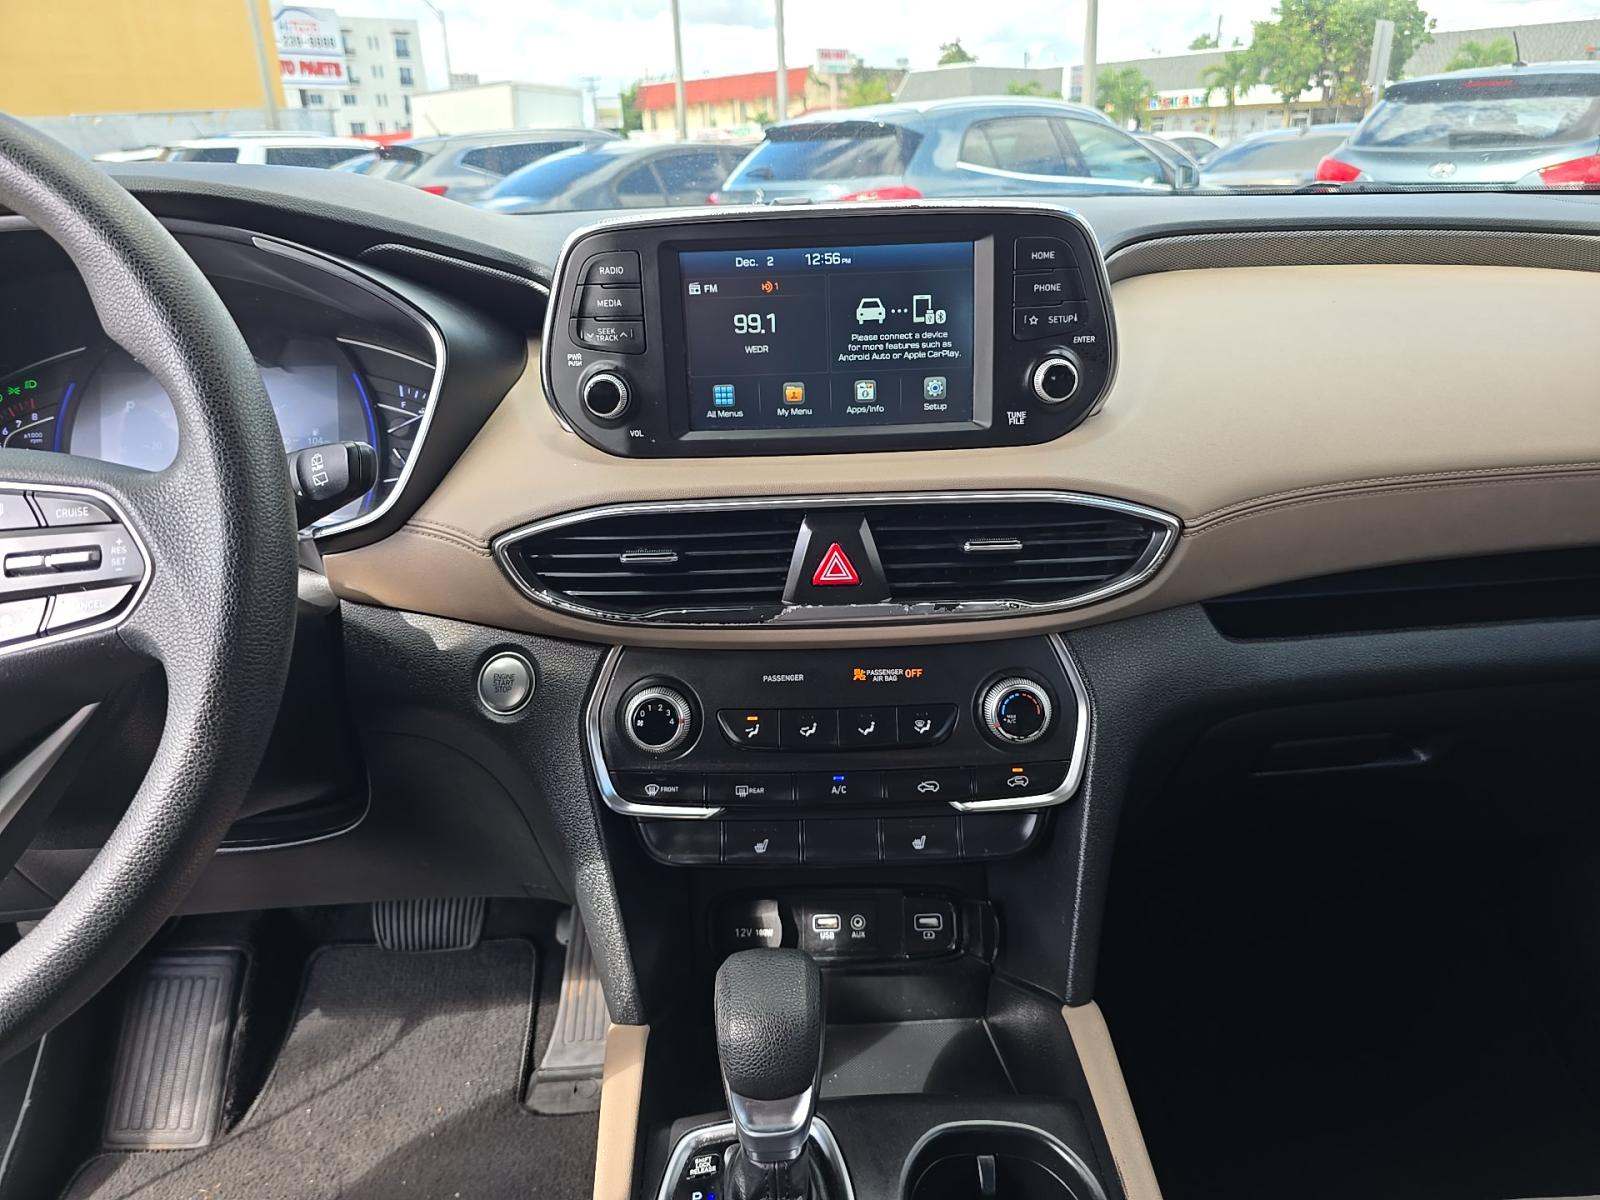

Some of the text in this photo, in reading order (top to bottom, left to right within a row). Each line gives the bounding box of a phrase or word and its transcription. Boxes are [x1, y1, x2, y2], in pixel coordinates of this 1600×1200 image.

[804, 252, 841, 266] 12:56
[1031, 251, 1055, 260] HOME
[735, 256, 774, 267] Dec. 2
[599, 266, 624, 275] RADIO
[703, 284, 718, 293] FM
[1033, 283, 1062, 292] PHONE
[597, 299, 622, 308] MEDIA
[733, 313, 776, 334] 99.1
[1048, 315, 1073, 324] SETUP
[597, 327, 616, 335] SEEK
[596, 334, 619, 342] TRACK
[851, 334, 878, 342] Please
[879, 332, 913, 341] connect
[921, 331, 948, 339] device
[1072, 335, 1096, 344] ENTER
[744, 345, 769, 354] WEDR
[885, 342, 920, 350] features
[567, 353, 582, 361] PWR
[838, 353, 870, 361] Android
[871, 352, 891, 360] Auto
[903, 351, 927, 360] Apple
[927, 350, 962, 359] CarPlay.
[846, 405, 885, 414] Apps/Info
[923, 402, 948, 412] Setup
[706, 409, 744, 418] All Menus
[777, 407, 812, 417] My Menu
[1006, 411, 1027, 419] TUNE
[15, 420, 22, 428] 7
[1008, 417, 1025, 425] FILE
[2, 427, 8, 436] 6
[629, 429, 644, 437] VOL
[55, 506, 89, 518] CRUISE
[762, 673, 804, 682] PASSENGER
[866, 668, 923, 679] PASSENGER OFF
[495, 685, 512, 693] STOP
[647, 704, 652, 712] 1
[657, 704, 663, 712] 2
[666, 709, 671, 717] 3
[831, 785, 847, 795] A/C
[735, 928, 752, 938] 12V
[819, 931, 835, 940] USB
[851, 930, 866, 939] AUX
[694, 1156, 712, 1164] SHIFT
[690, 1165, 717, 1176] RELEASE
[692, 1191, 703, 1200] P
